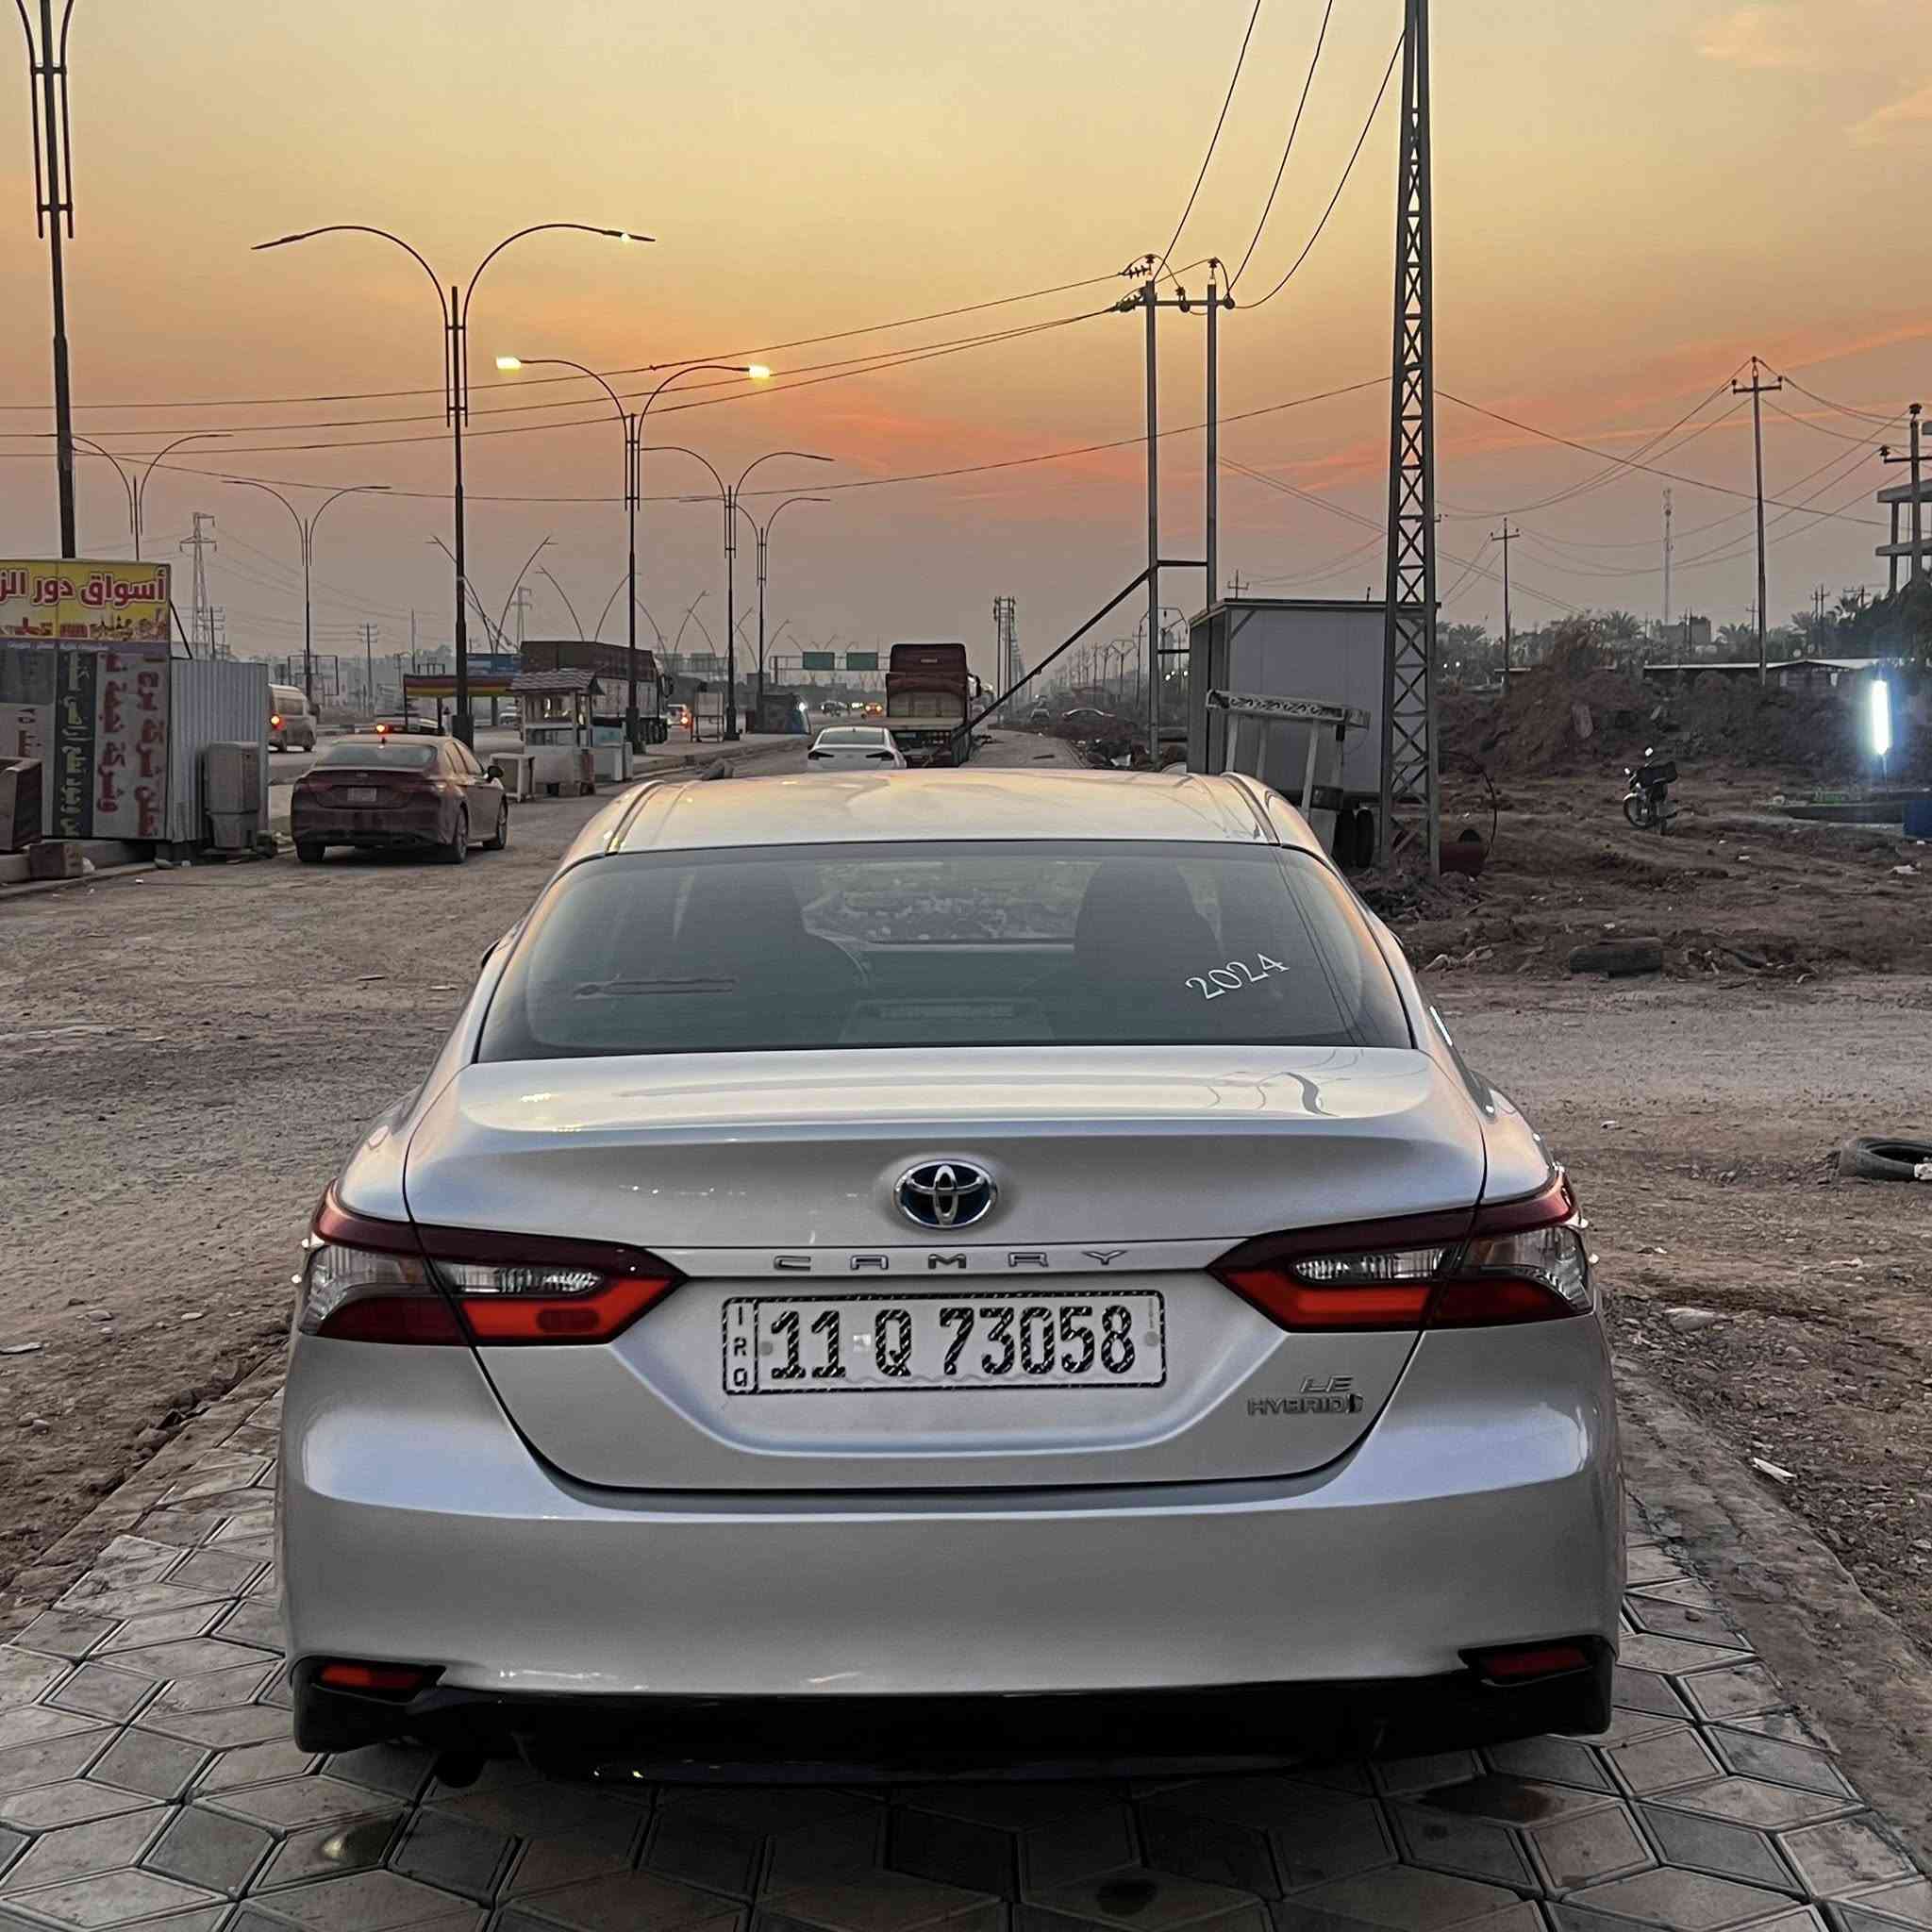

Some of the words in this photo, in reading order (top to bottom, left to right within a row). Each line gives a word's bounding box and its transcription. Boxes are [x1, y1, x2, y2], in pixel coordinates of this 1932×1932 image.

[0, 570, 27, 604] الز
[32, 576, 76, 606] دور
[81, 568, 167, 608] أسواق
[1185, 952, 1291, 999] 2024
[774, 1249, 1128, 1272] CAMRY
[733, 1306, 748, 1387] IRQ
[771, 1310, 846, 1379] 11
[874, 1309, 912, 1376] Q
[940, 1305, 1135, 1375] 73058
[1300, 1374, 1353, 1392] LE
[1246, 1395, 1347, 1416] HYBRID
